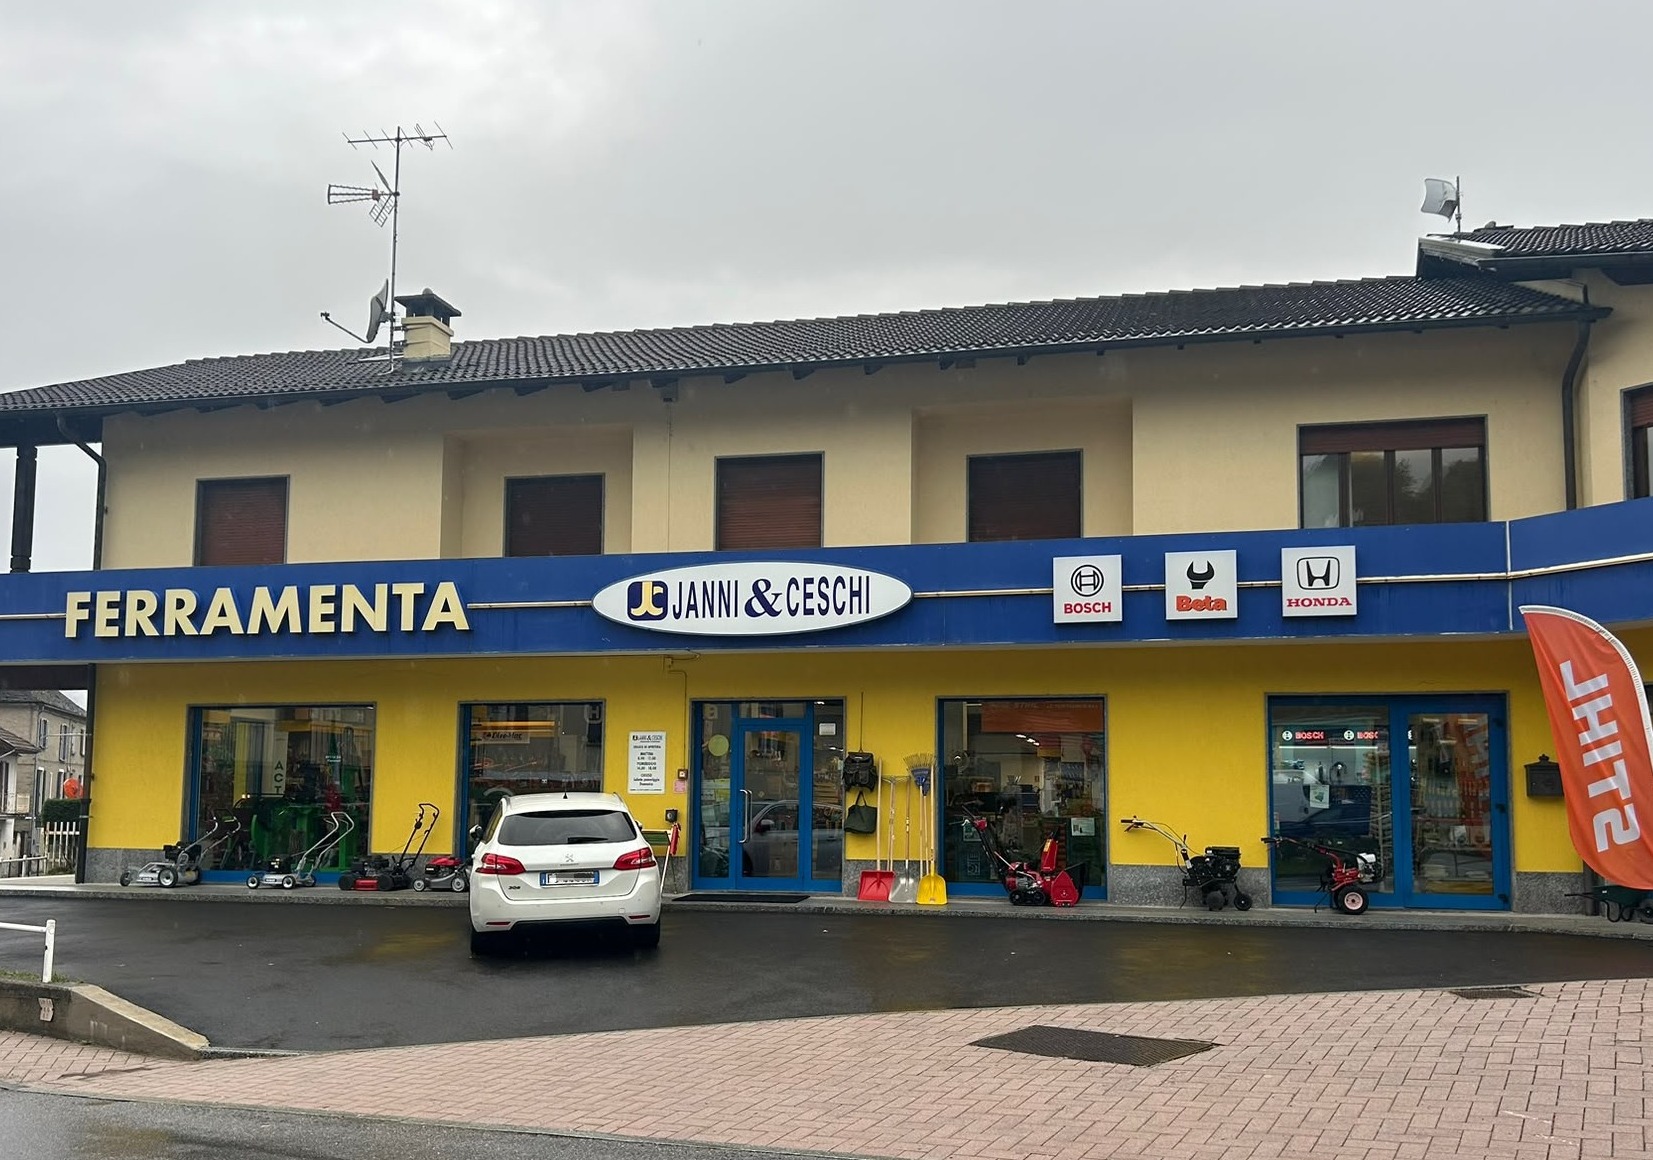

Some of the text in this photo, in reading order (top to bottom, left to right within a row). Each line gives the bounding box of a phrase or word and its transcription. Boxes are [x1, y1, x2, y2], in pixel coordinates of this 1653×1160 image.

[672, 575, 871, 620] JANNI & CESCHI
[1175, 594, 1228, 612] Beta
[1286, 596, 1353, 608] HONDA
[64, 581, 470, 638] FERRAMENTA
[1063, 601, 1112, 614] BOSCH
[1295, 730, 1324, 740] BOSCH
